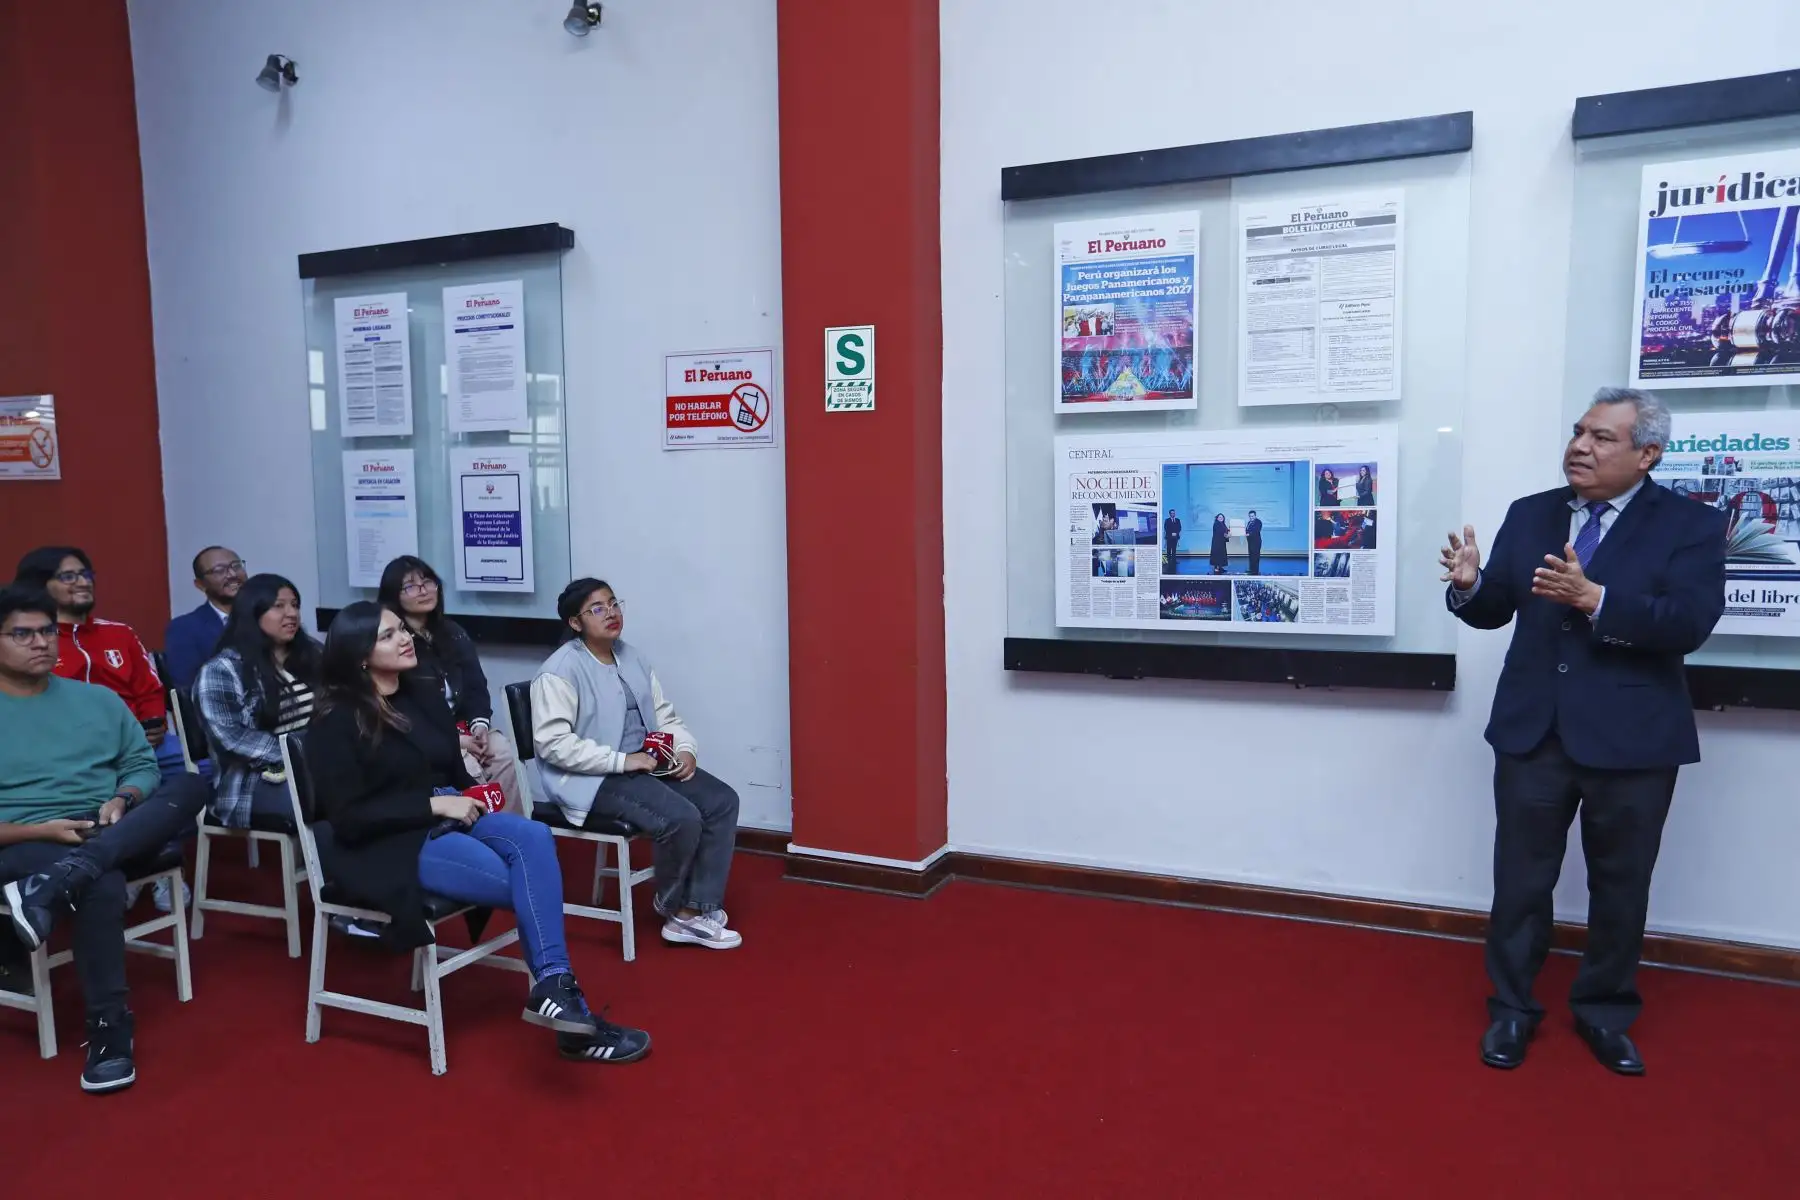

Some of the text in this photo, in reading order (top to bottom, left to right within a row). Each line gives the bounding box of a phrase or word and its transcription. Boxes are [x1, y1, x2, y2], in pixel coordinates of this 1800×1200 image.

[1649, 172, 1800, 217] jurídica
[1291, 210, 1348, 222] El Peruano
[1282, 220, 1357, 234] BOLETÍN OFICIAL
[1088, 238, 1166, 254] El Peruano
[1078, 265, 1177, 280] Perú organizará los
[1650, 268, 1745, 284] El recurso
[1066, 274, 1190, 292] Juegos Panamericanos y
[1649, 279, 1754, 299] de casación
[1063, 284, 1192, 303] Parapanamericanos 2027
[466, 299, 500, 308] El Peruano
[361, 308, 389, 316] Peruano
[836, 334, 865, 375] S
[684, 369, 752, 382] El Peruano
[688, 401, 721, 410] HABLAR
[686, 411, 728, 421] TELÉFONO
[1664, 433, 1790, 453] ariedades
[1069, 450, 1114, 459] CENTRAL
[363, 464, 394, 472] El Peruano
[472, 462, 506, 470] El Peruano
[1076, 476, 1152, 490] NOCHE DE
[1072, 490, 1155, 499] RECONOCIMIENTO
[1728, 589, 1755, 603] del
